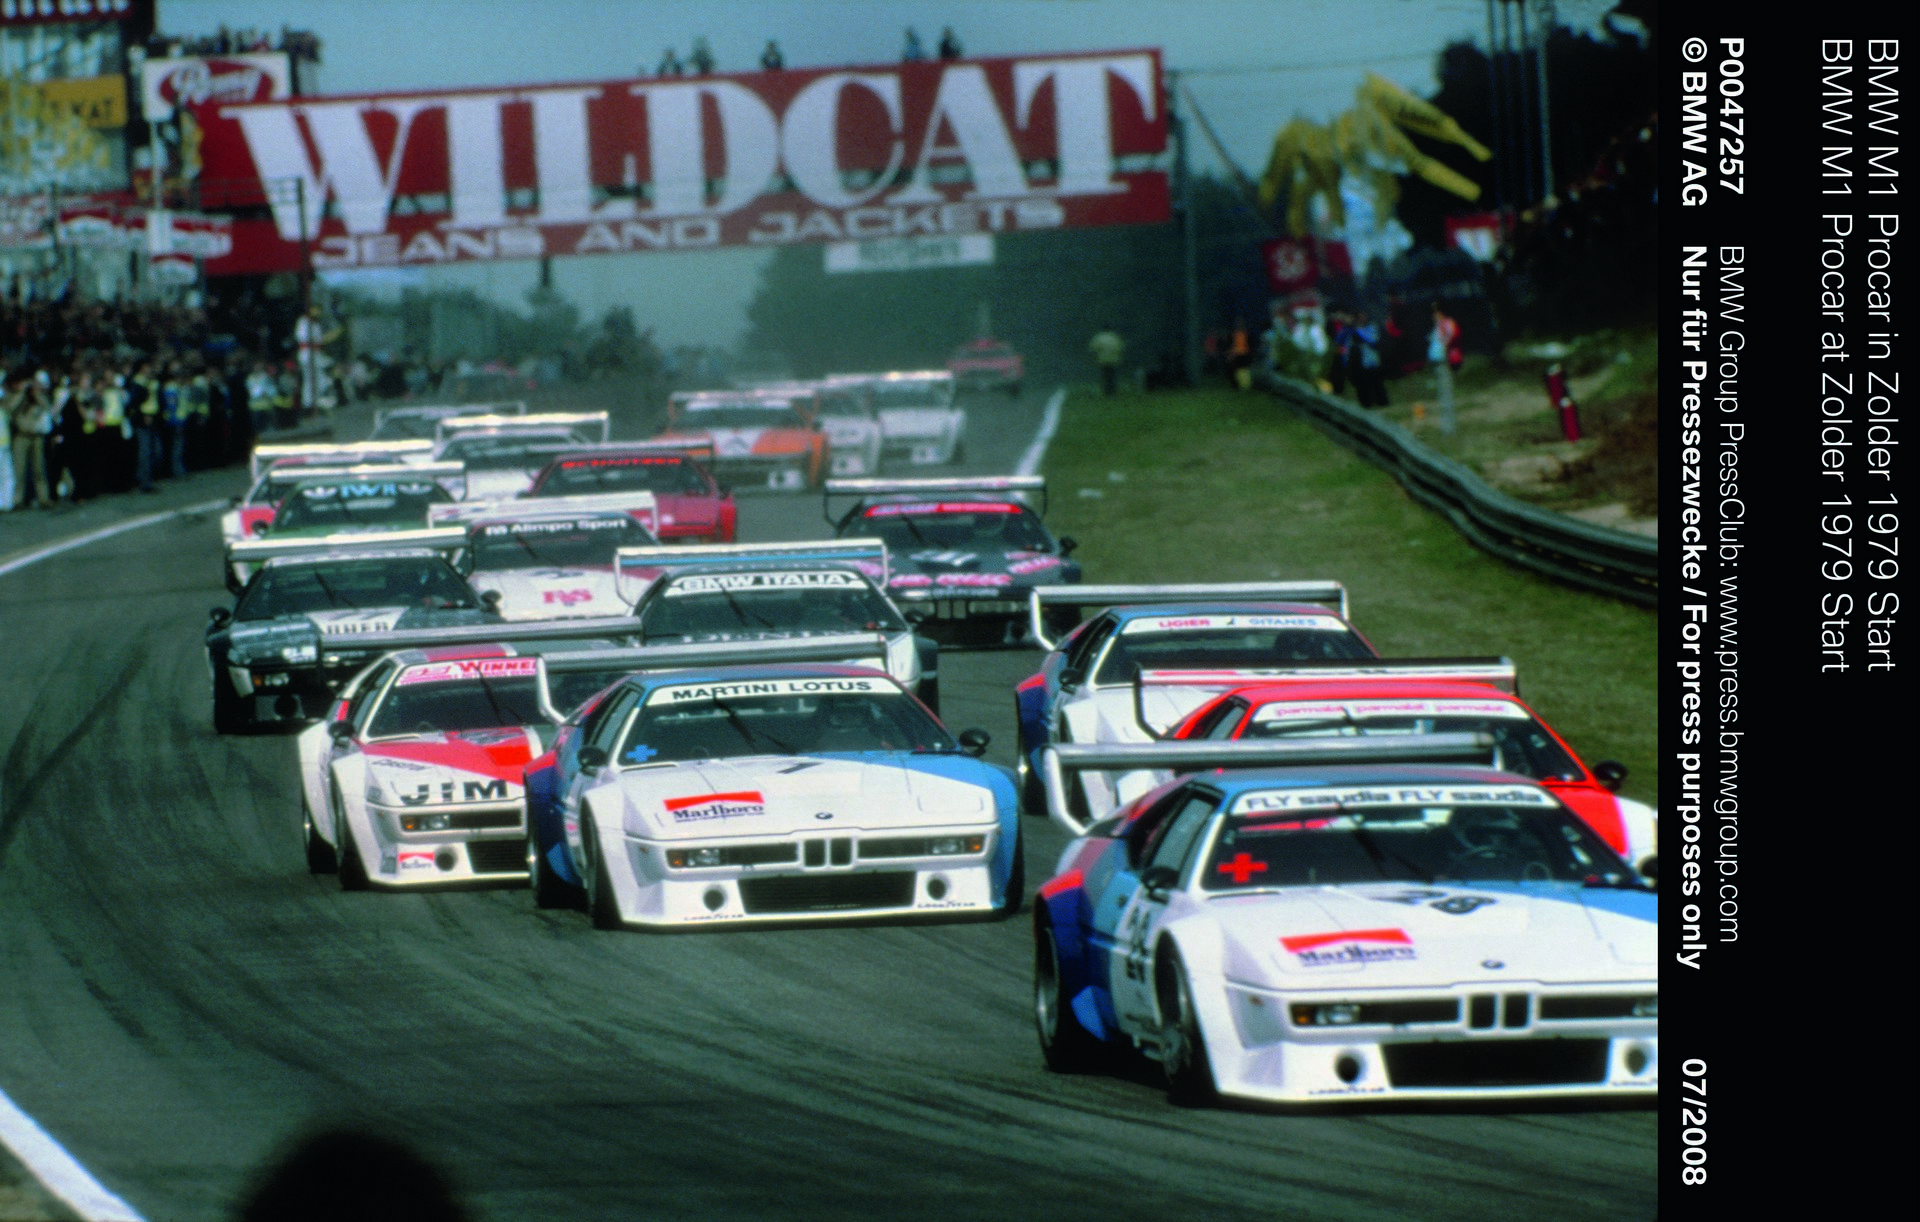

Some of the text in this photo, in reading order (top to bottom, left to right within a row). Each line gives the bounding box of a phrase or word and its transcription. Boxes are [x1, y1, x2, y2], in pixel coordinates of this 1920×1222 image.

[220, 52, 1158, 241] WILDCAT
[309, 200, 1067, 266] JEANS AND JACKETS
[577, 518, 628, 532] Sport
[682, 571, 846, 593] BMW ITALIA
[1157, 616, 1318, 629] LIGIER GITANES
[671, 680, 872, 701] MARTINI LOTUS
[400, 779, 508, 806] JIM
[1247, 788, 1542, 811] FLY saudia FLY saudia
[673, 804, 766, 820] Marlboro
[1296, 945, 1416, 963] Marlboro
